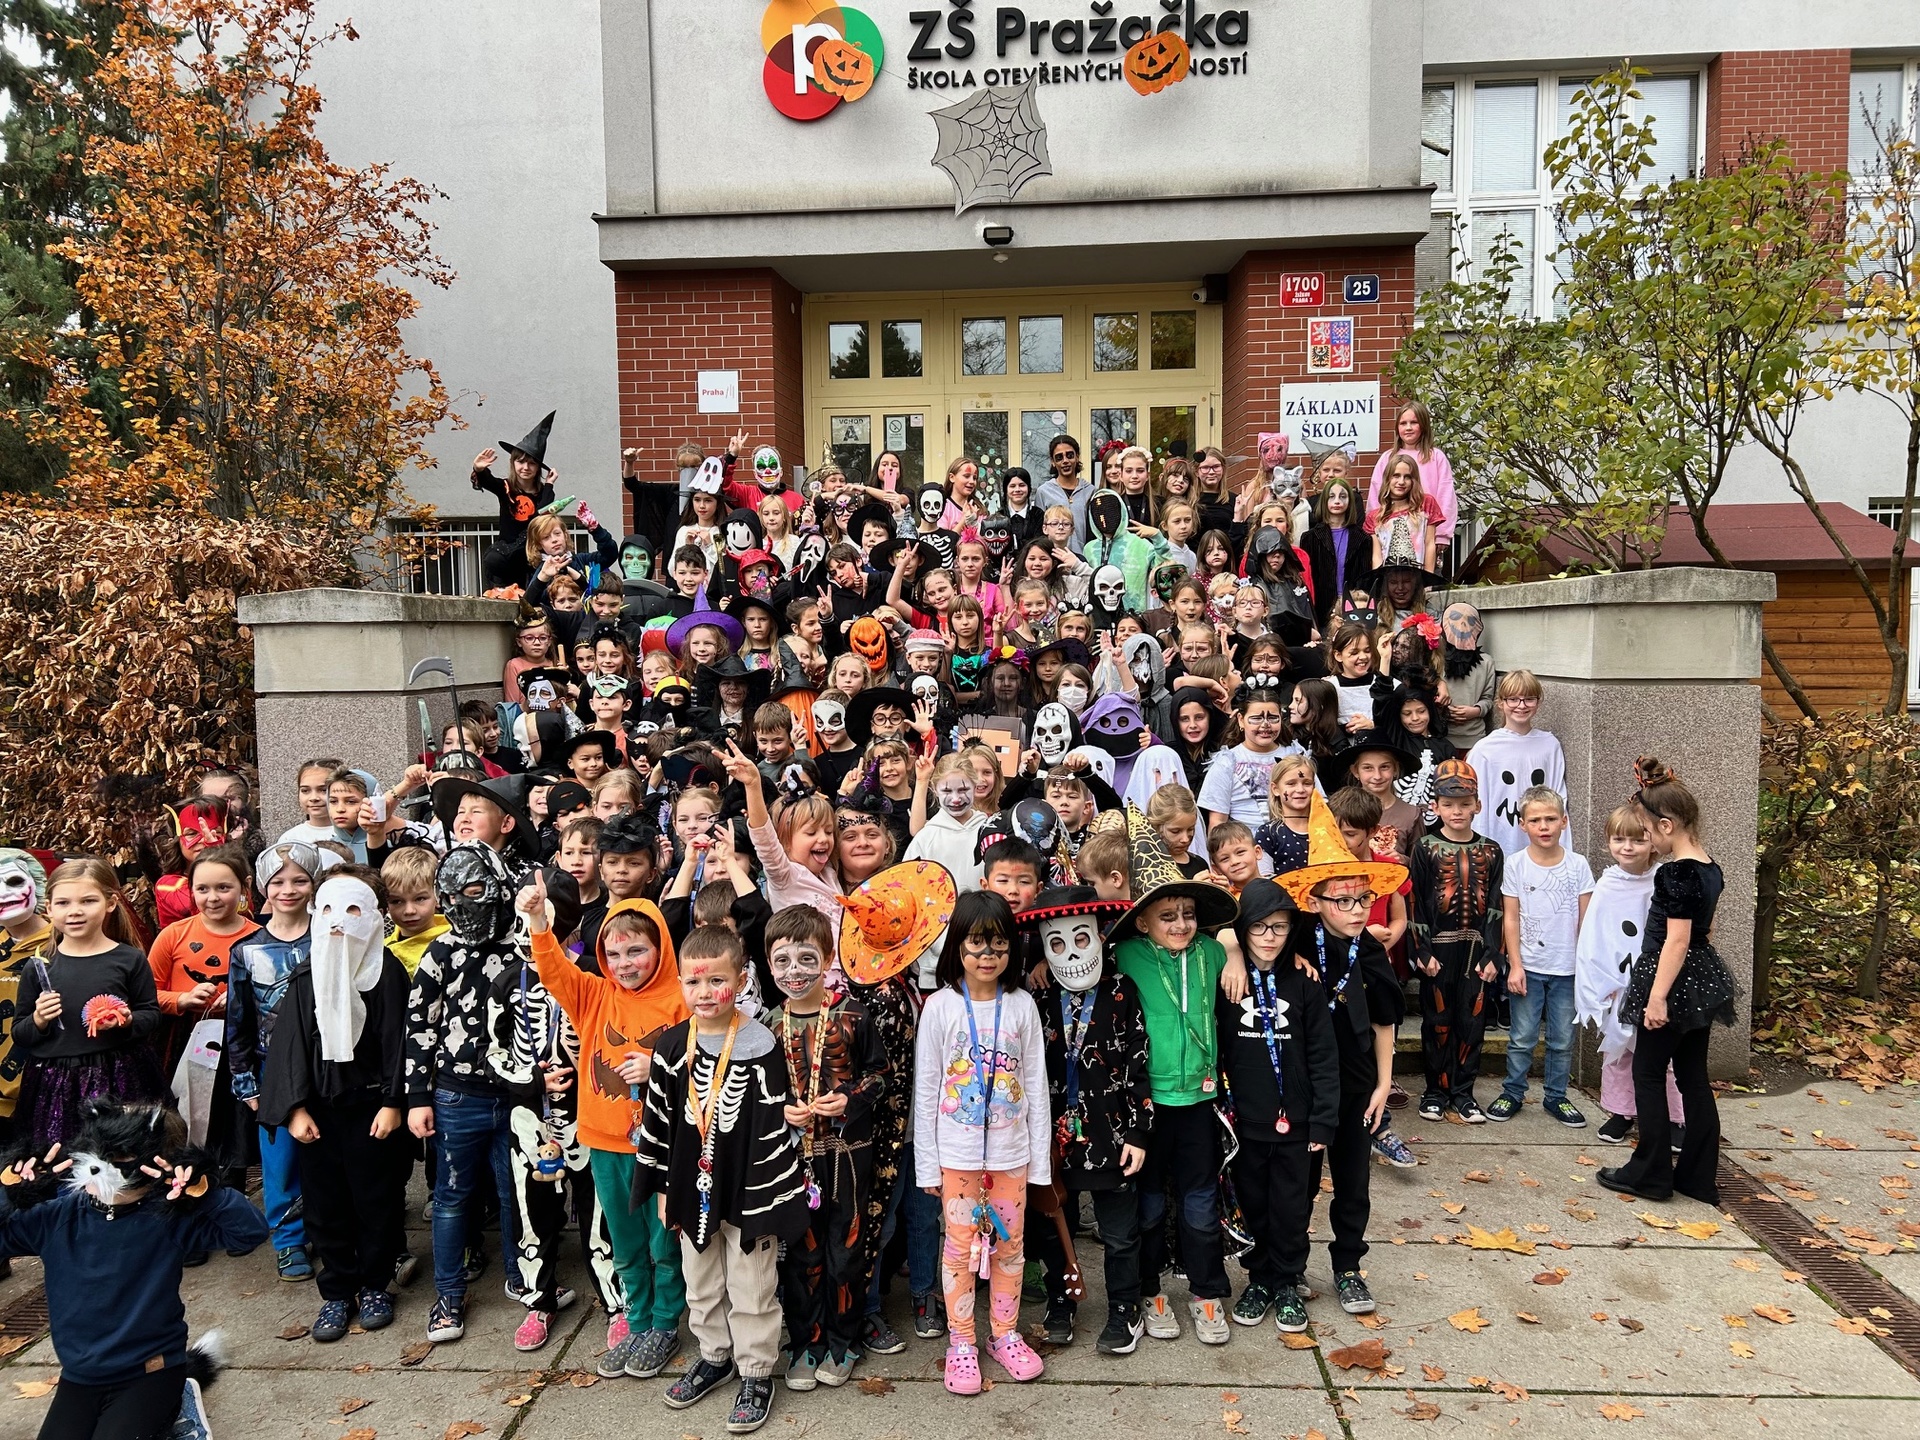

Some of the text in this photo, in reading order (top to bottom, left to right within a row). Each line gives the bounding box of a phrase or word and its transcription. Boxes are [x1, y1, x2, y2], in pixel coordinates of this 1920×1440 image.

[907, 0, 976, 61] ZŠ
[907, 66, 977, 90] ŠKOLA
[983, 59, 1122, 87] OTEVŘENÝCH
[1286, 276, 1320, 292] 1700
[1352, 281, 1371, 296] 25
[1286, 394, 1374, 416] ZÁKLADNÍ
[843, 425, 860, 442] A
[1301, 419, 1358, 438] ŠKOLA
[1237, 1031, 1261, 1039] UNDER
